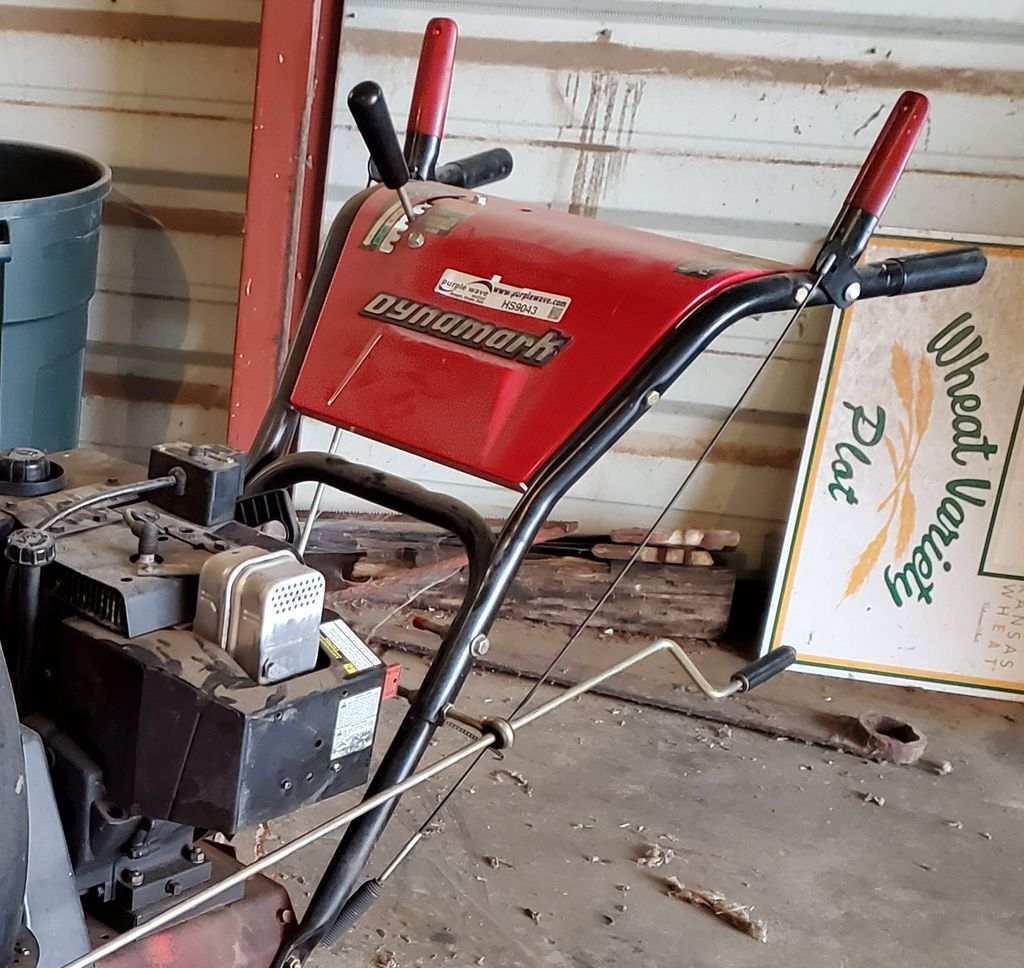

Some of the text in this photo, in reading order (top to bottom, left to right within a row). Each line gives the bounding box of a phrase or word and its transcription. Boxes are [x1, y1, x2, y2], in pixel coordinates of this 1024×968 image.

[441, 279, 467, 292] purple
[468, 287, 489, 298] wave
[493, 286, 568, 308] www.purplewave.com
[501, 299, 538, 315] HS9043
[830, 400, 886, 507] Plot
[884, 311, 999, 608] Wheat Variety
[984, 584, 1017, 665] WHEAT
